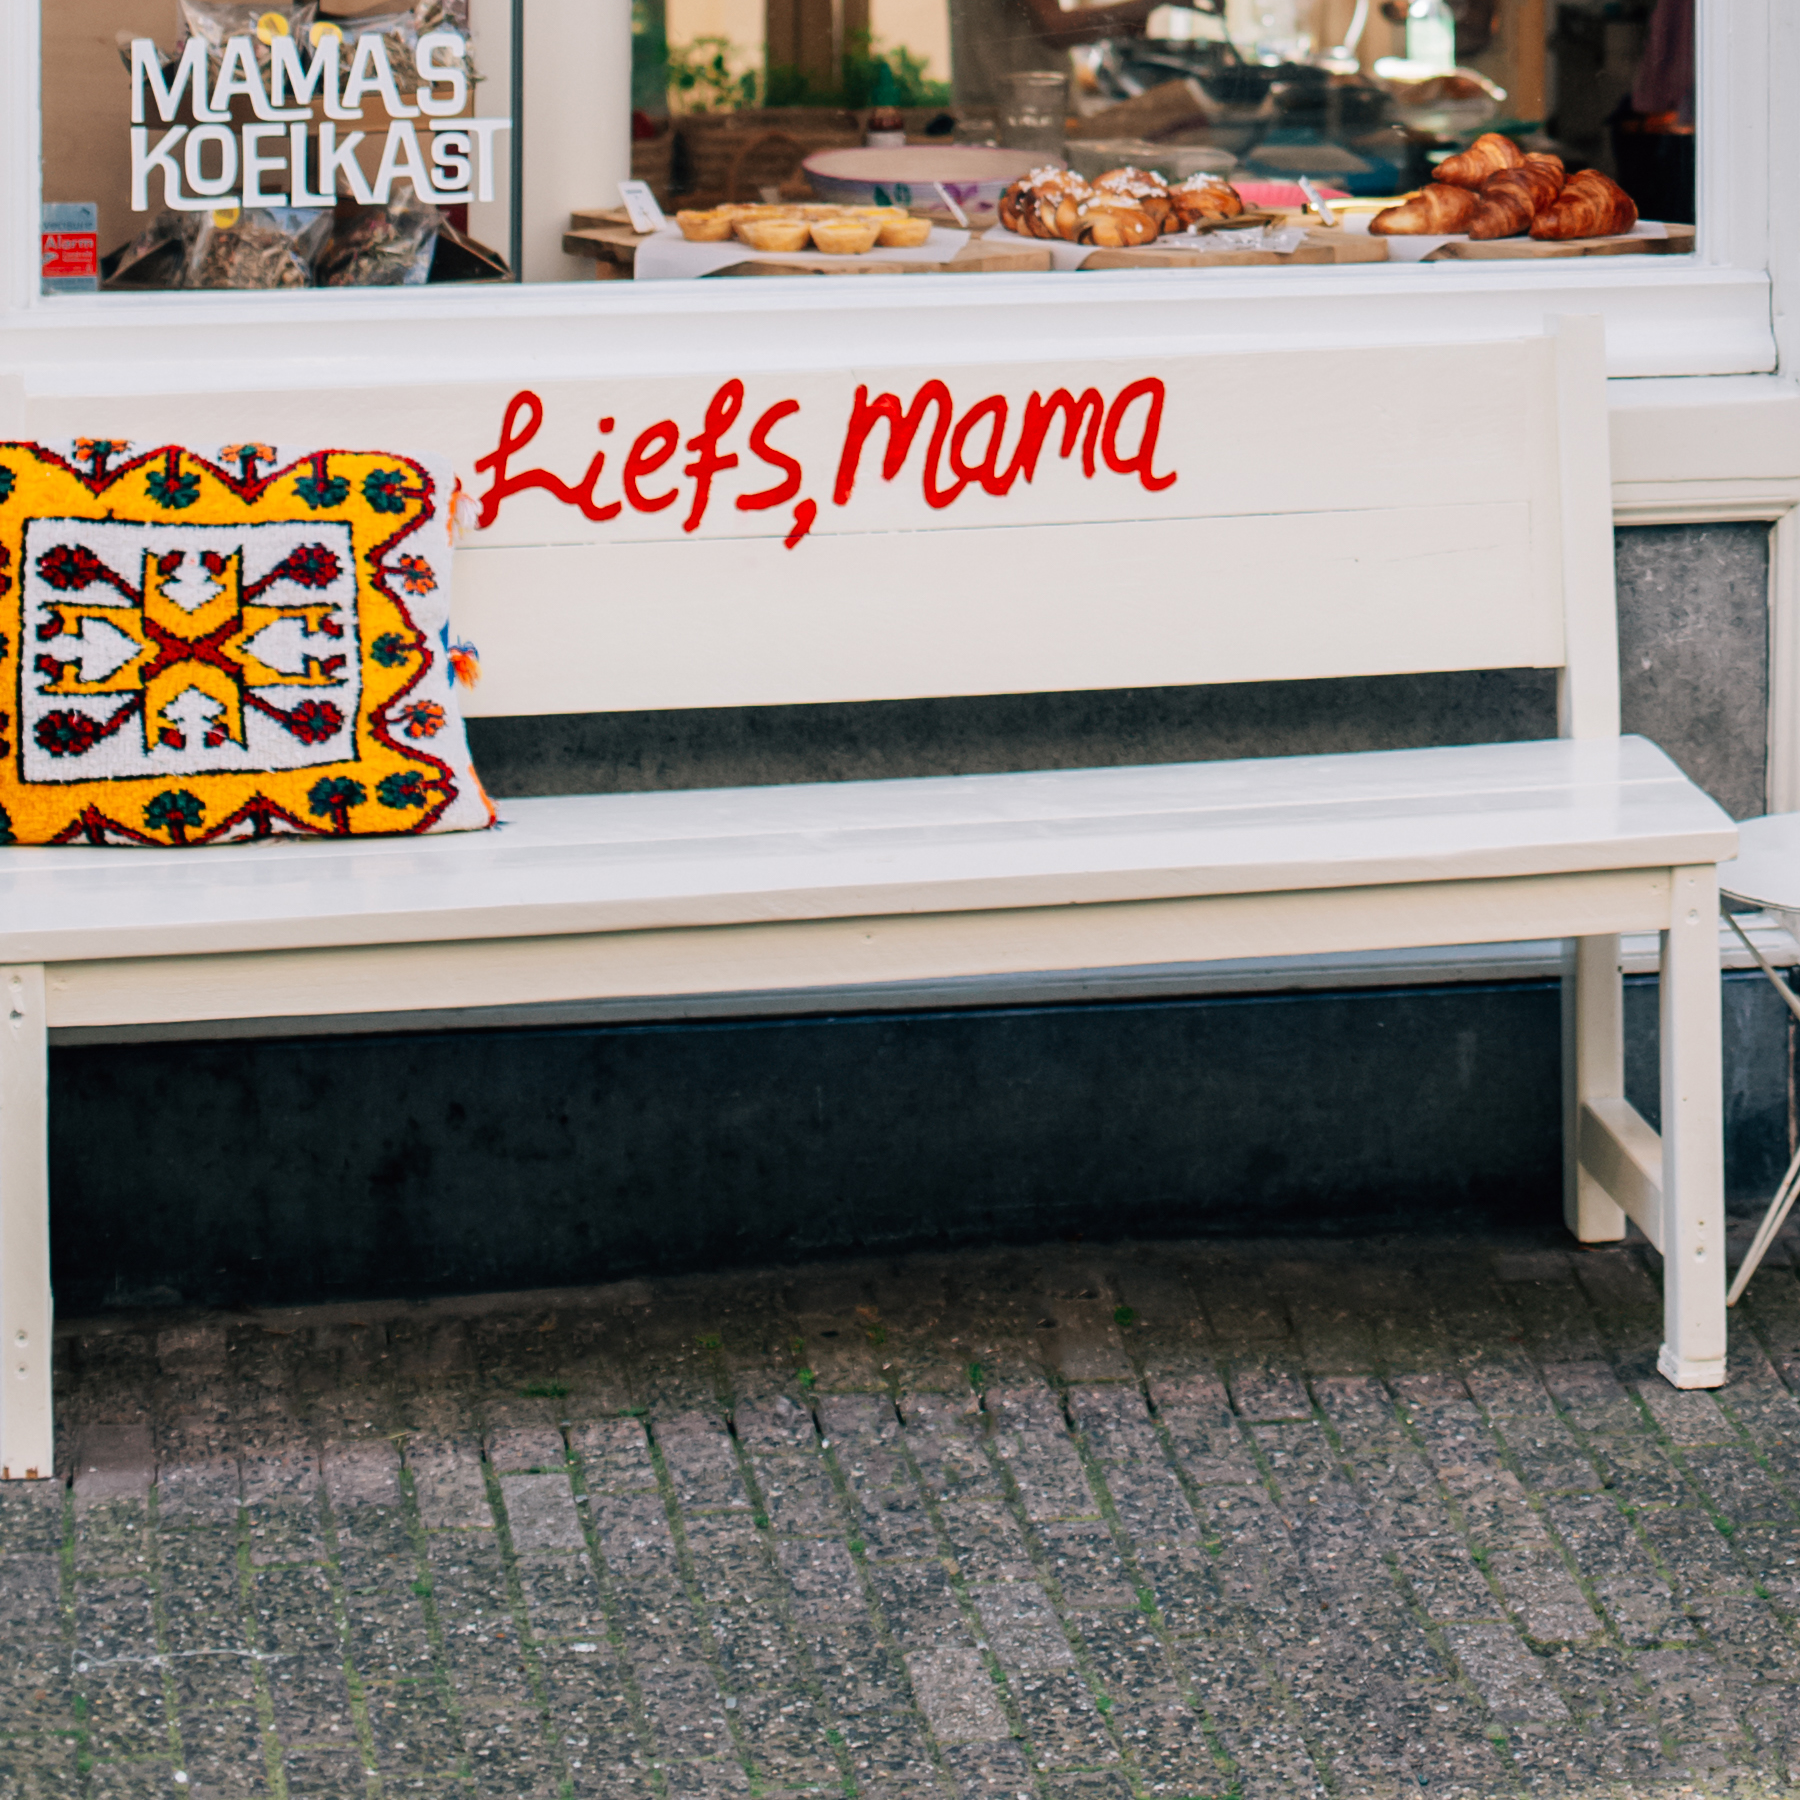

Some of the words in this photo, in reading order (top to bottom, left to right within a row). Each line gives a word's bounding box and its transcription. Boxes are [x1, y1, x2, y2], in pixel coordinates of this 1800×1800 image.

[130, 117, 512, 212] KOELKAST
[44, 235, 94, 250] Alarm
[474, 378, 817, 550] Liefs,
